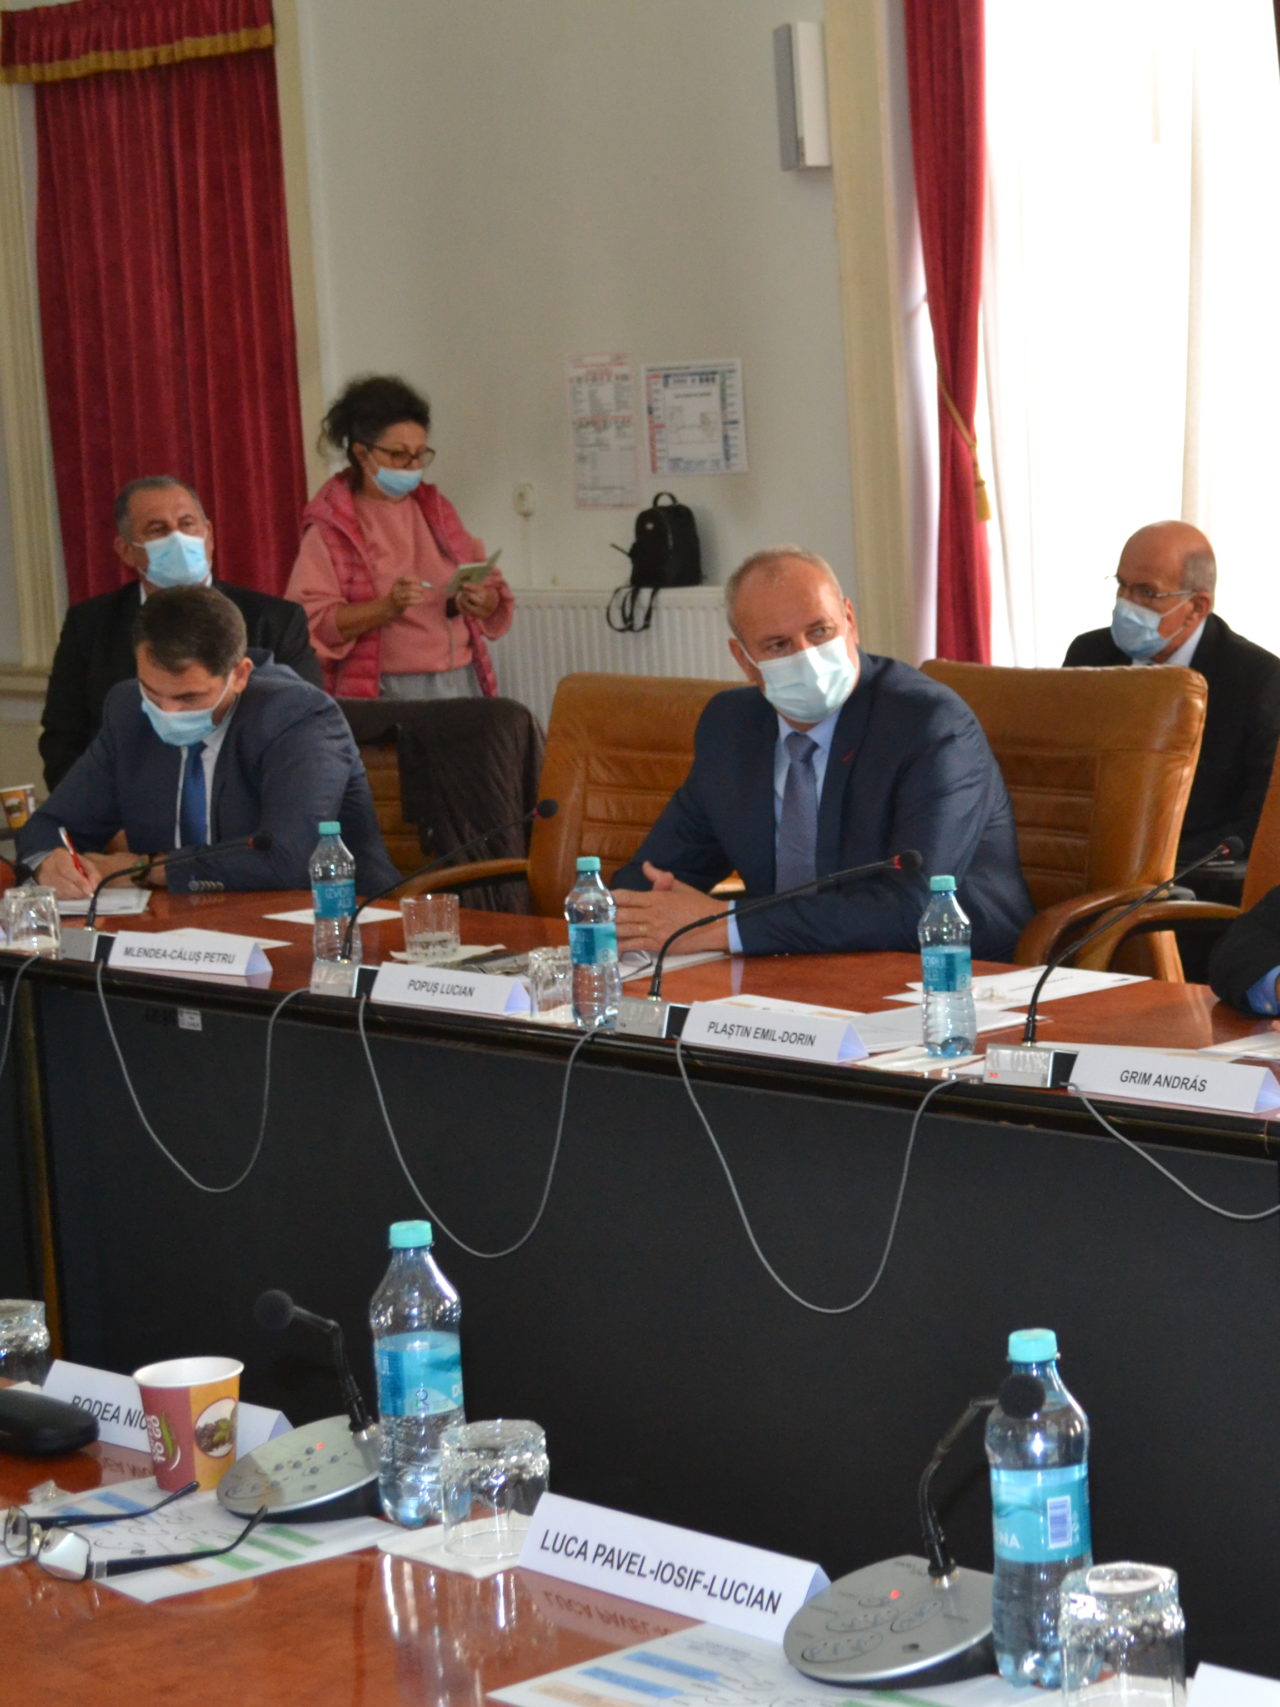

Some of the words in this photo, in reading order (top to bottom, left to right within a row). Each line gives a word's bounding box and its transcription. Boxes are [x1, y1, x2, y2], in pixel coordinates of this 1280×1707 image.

[203, 952, 235, 964] PETRU
[440, 983, 475, 997] LUCIAN
[753, 1027, 817, 1046] EMIL-DORIN
[1120, 1070, 1152, 1086] GRIM
[1153, 1074, 1208, 1092] ANDRÁS
[540, 1529, 588, 1562] LUCA
[592, 1543, 782, 1615] PAVEL-IOSIF-LUCIAN
